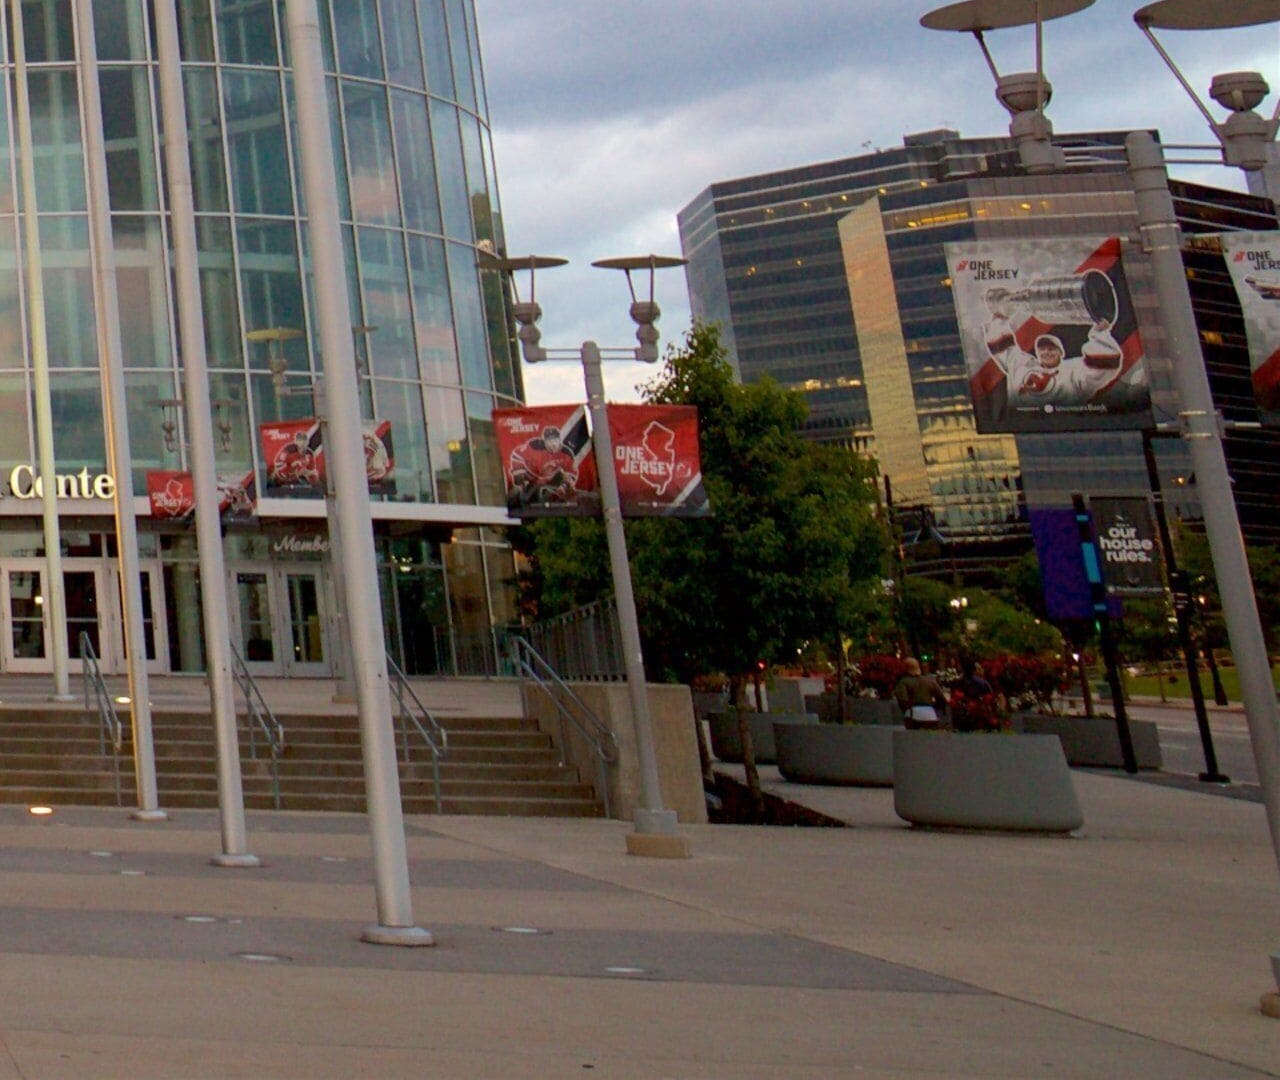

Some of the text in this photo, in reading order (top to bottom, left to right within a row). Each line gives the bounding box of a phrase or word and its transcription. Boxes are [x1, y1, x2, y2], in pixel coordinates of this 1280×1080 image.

[1246, 250, 1271, 261] ONE
[969, 259, 993, 271] ONE
[1253, 260, 1280, 271] JERS
[974, 269, 1019, 281] JERSEY
[615, 446, 645, 460] ONE
[621, 461, 674, 474] JERSEY
[1108, 527, 1137, 538] our
[1099, 535, 1153, 550] house
[1106, 550, 1152, 562] rules.
